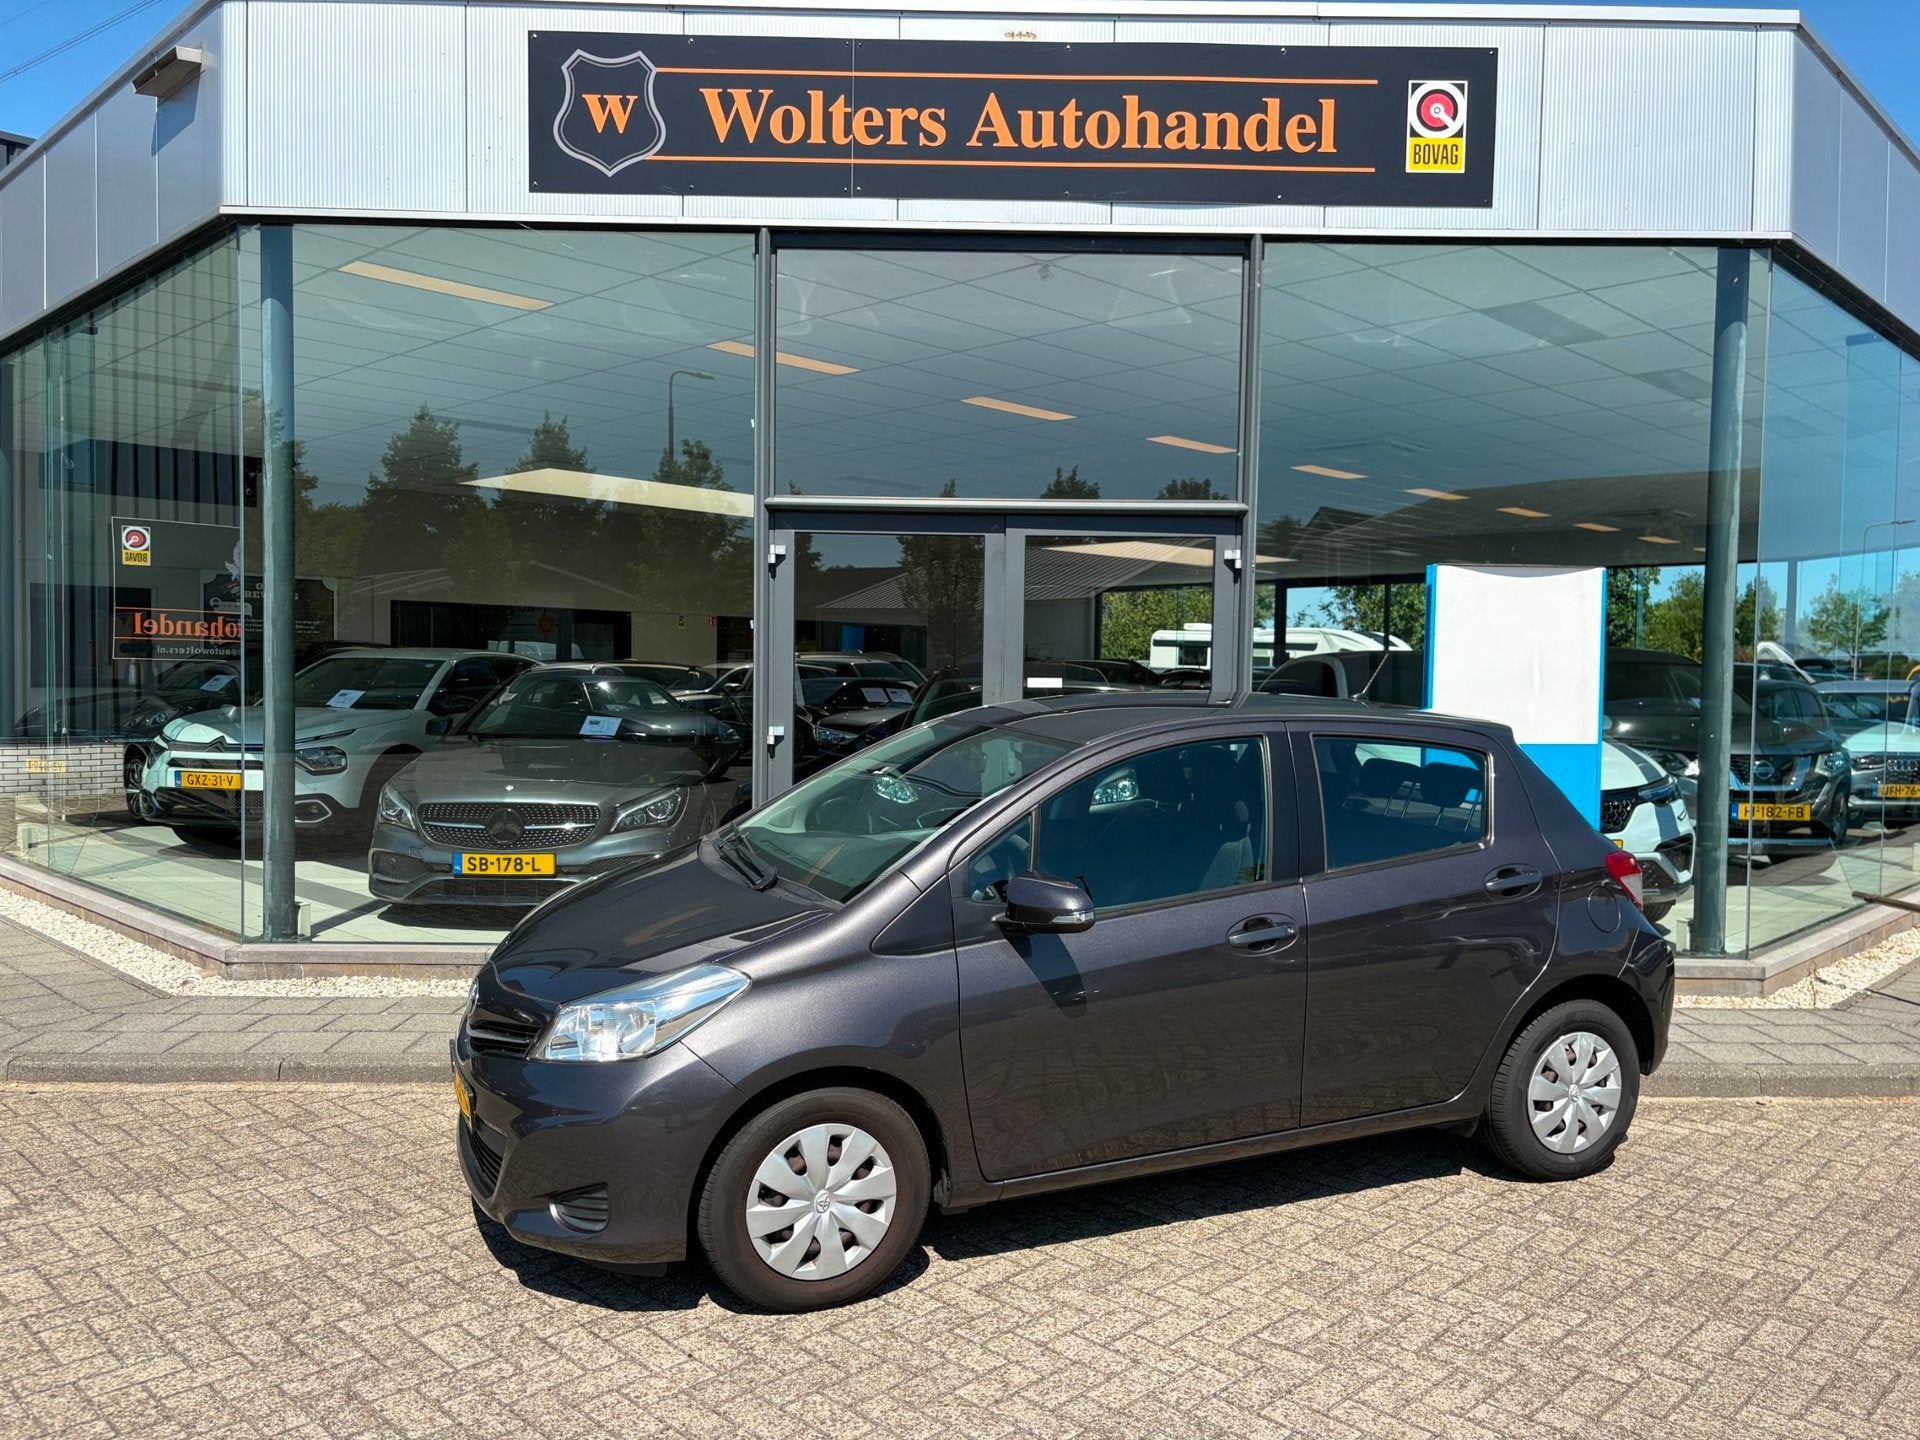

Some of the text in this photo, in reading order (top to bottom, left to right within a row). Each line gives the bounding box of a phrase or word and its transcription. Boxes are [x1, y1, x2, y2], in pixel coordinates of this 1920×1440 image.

[583, 94, 638, 134] W
[700, 88, 1338, 153] Wolters Autohandel
[1413, 143, 1459, 165] BOVAG
[187, 774, 234, 787] GXZ-31-V
[467, 856, 541, 872] SB-178-L
